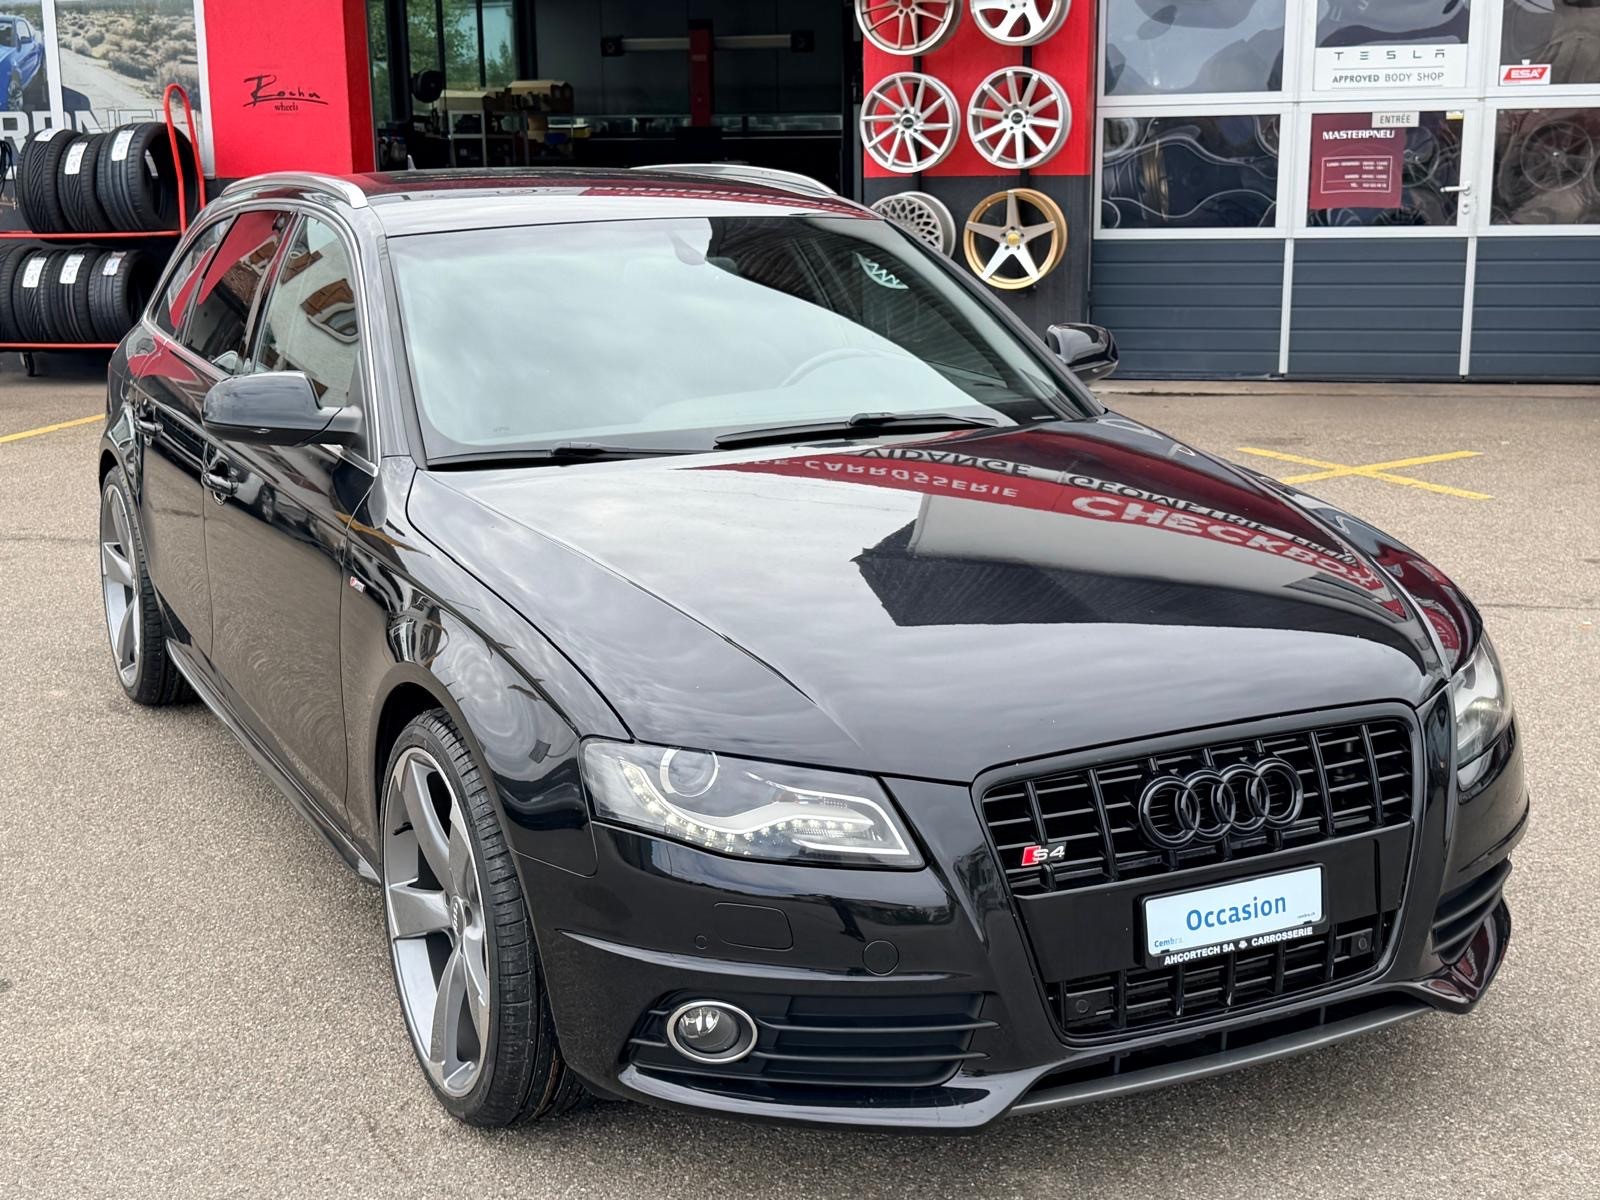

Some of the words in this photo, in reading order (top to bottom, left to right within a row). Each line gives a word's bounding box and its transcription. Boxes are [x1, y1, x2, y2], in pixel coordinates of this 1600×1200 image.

[1334, 49, 1446, 61] TESLA
[1332, 74, 1380, 84] APPROVED
[1384, 73, 1412, 82] BODY
[1417, 71, 1445, 81] SHOP
[1510, 68, 1540, 79] ESA
[274, 102, 299, 112] wheels
[1379, 114, 1411, 125] ENTRÉE
[1322, 129, 1395, 141] MASTERPNEU
[1033, 845, 1065, 861] S4
[1186, 896, 1286, 931] Occasion
[1164, 945, 1221, 966] AHCORTECH
[1222, 942, 1236, 953] SA
[1251, 926, 1313, 947] CARROSSERIE
